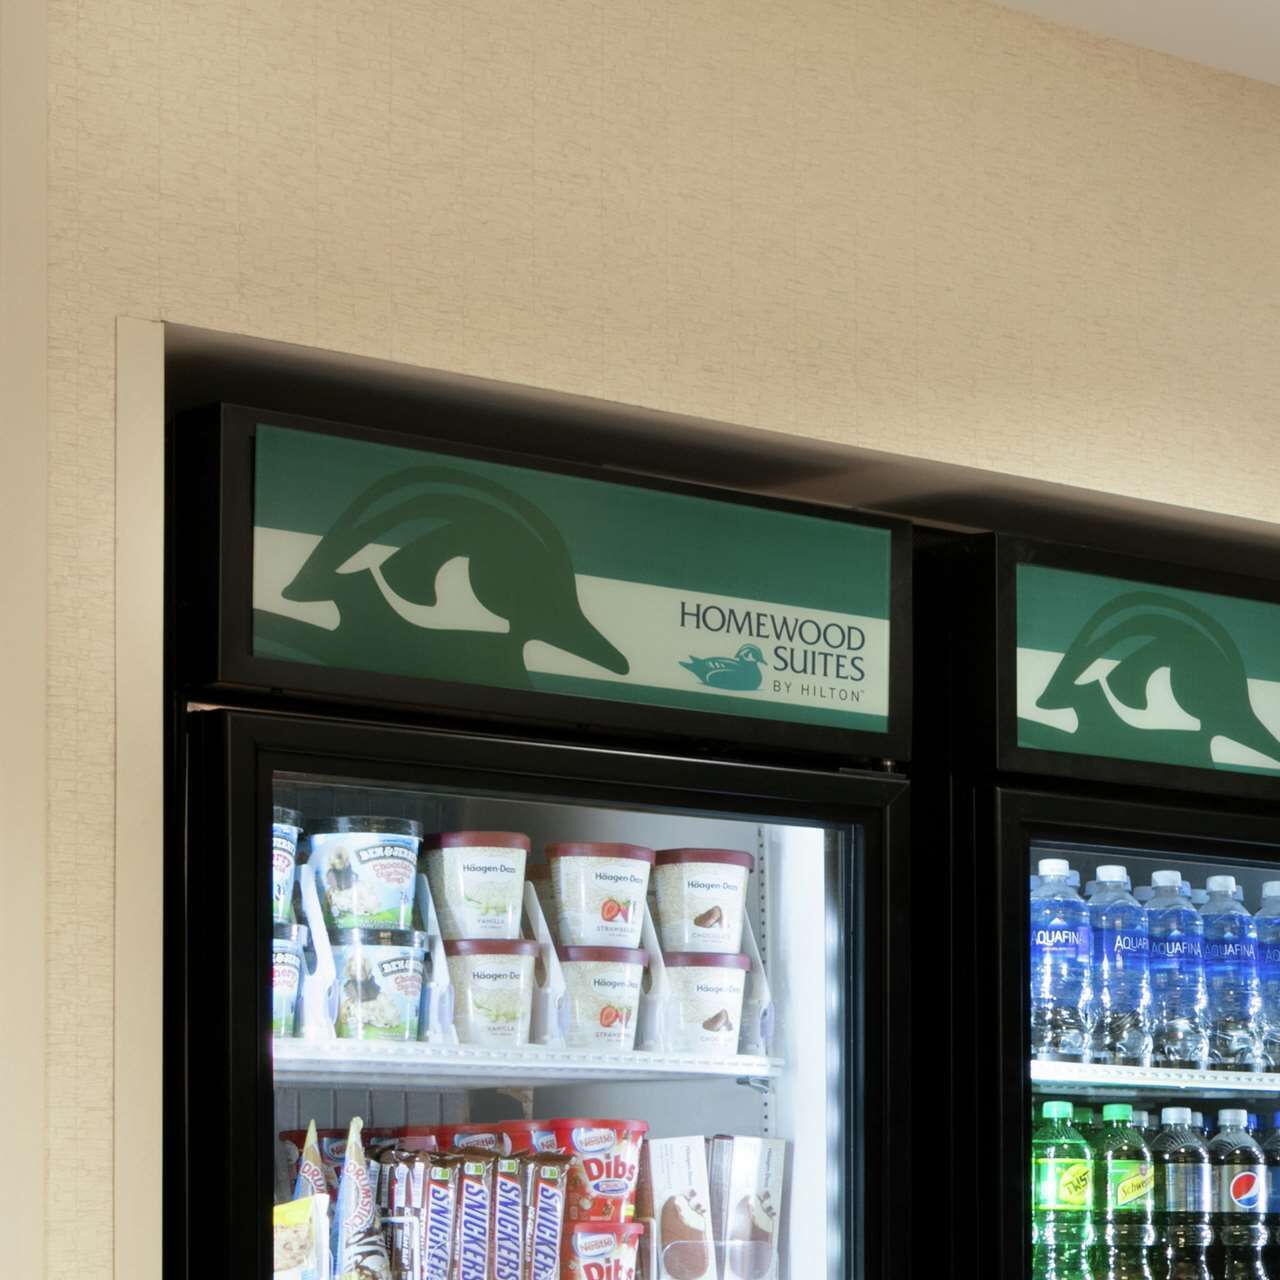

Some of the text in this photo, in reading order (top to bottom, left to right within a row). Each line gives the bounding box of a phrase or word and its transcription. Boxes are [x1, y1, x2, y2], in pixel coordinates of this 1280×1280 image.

[680, 601, 866, 651] HOMEWOOD
[773, 646, 865, 681] SUITES
[773, 680, 792, 695] BY
[1151, 941, 1201, 957] AQUAFINA
[1205, 943, 1256, 960] AQUAFINA
[583, 1154, 635, 1182] Dibs
[345, 1162, 375, 1232] DRUMSTICK
